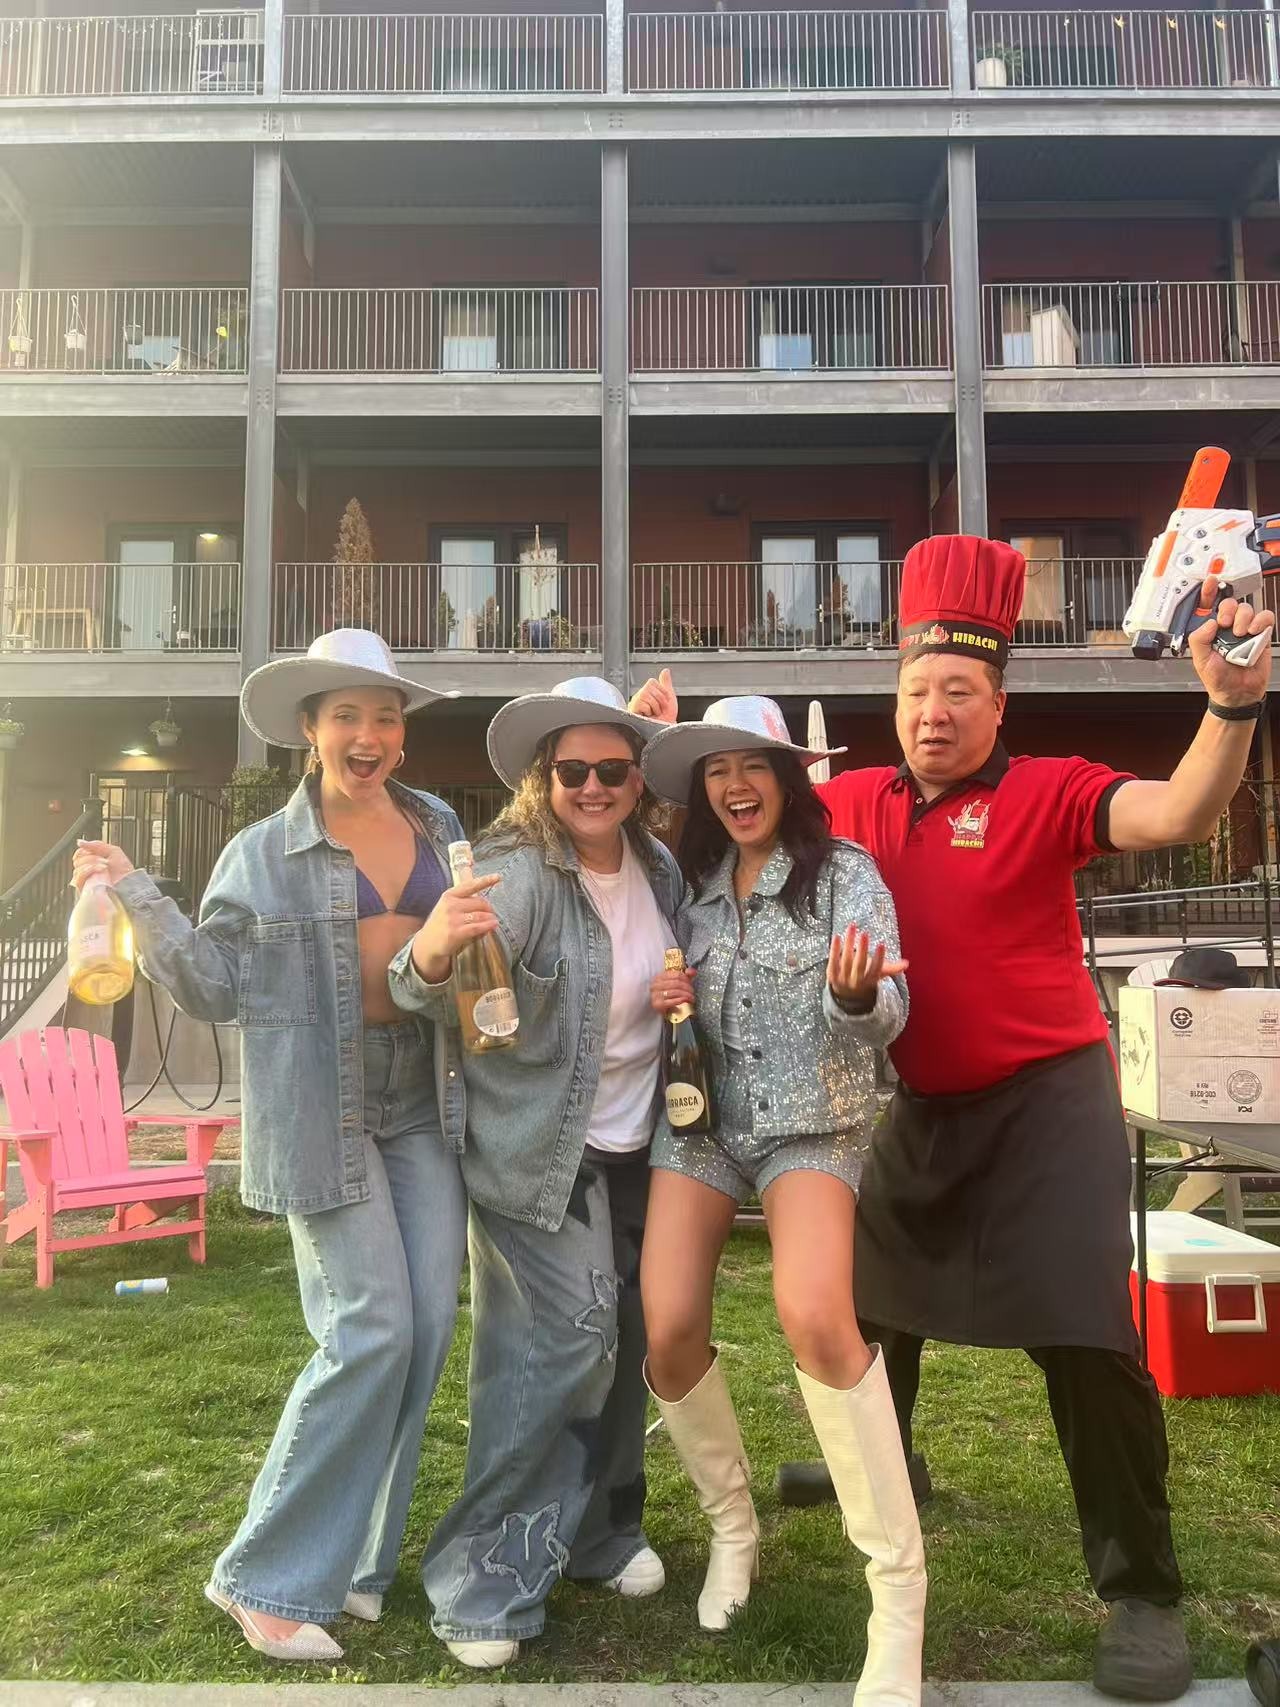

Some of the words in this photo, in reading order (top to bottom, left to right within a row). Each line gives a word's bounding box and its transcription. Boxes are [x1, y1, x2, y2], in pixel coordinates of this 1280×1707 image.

[952, 631, 998, 651] HIBACHI
[951, 839, 985, 848] HIBACHI
[1237, 1105, 1253, 1113] PCA
